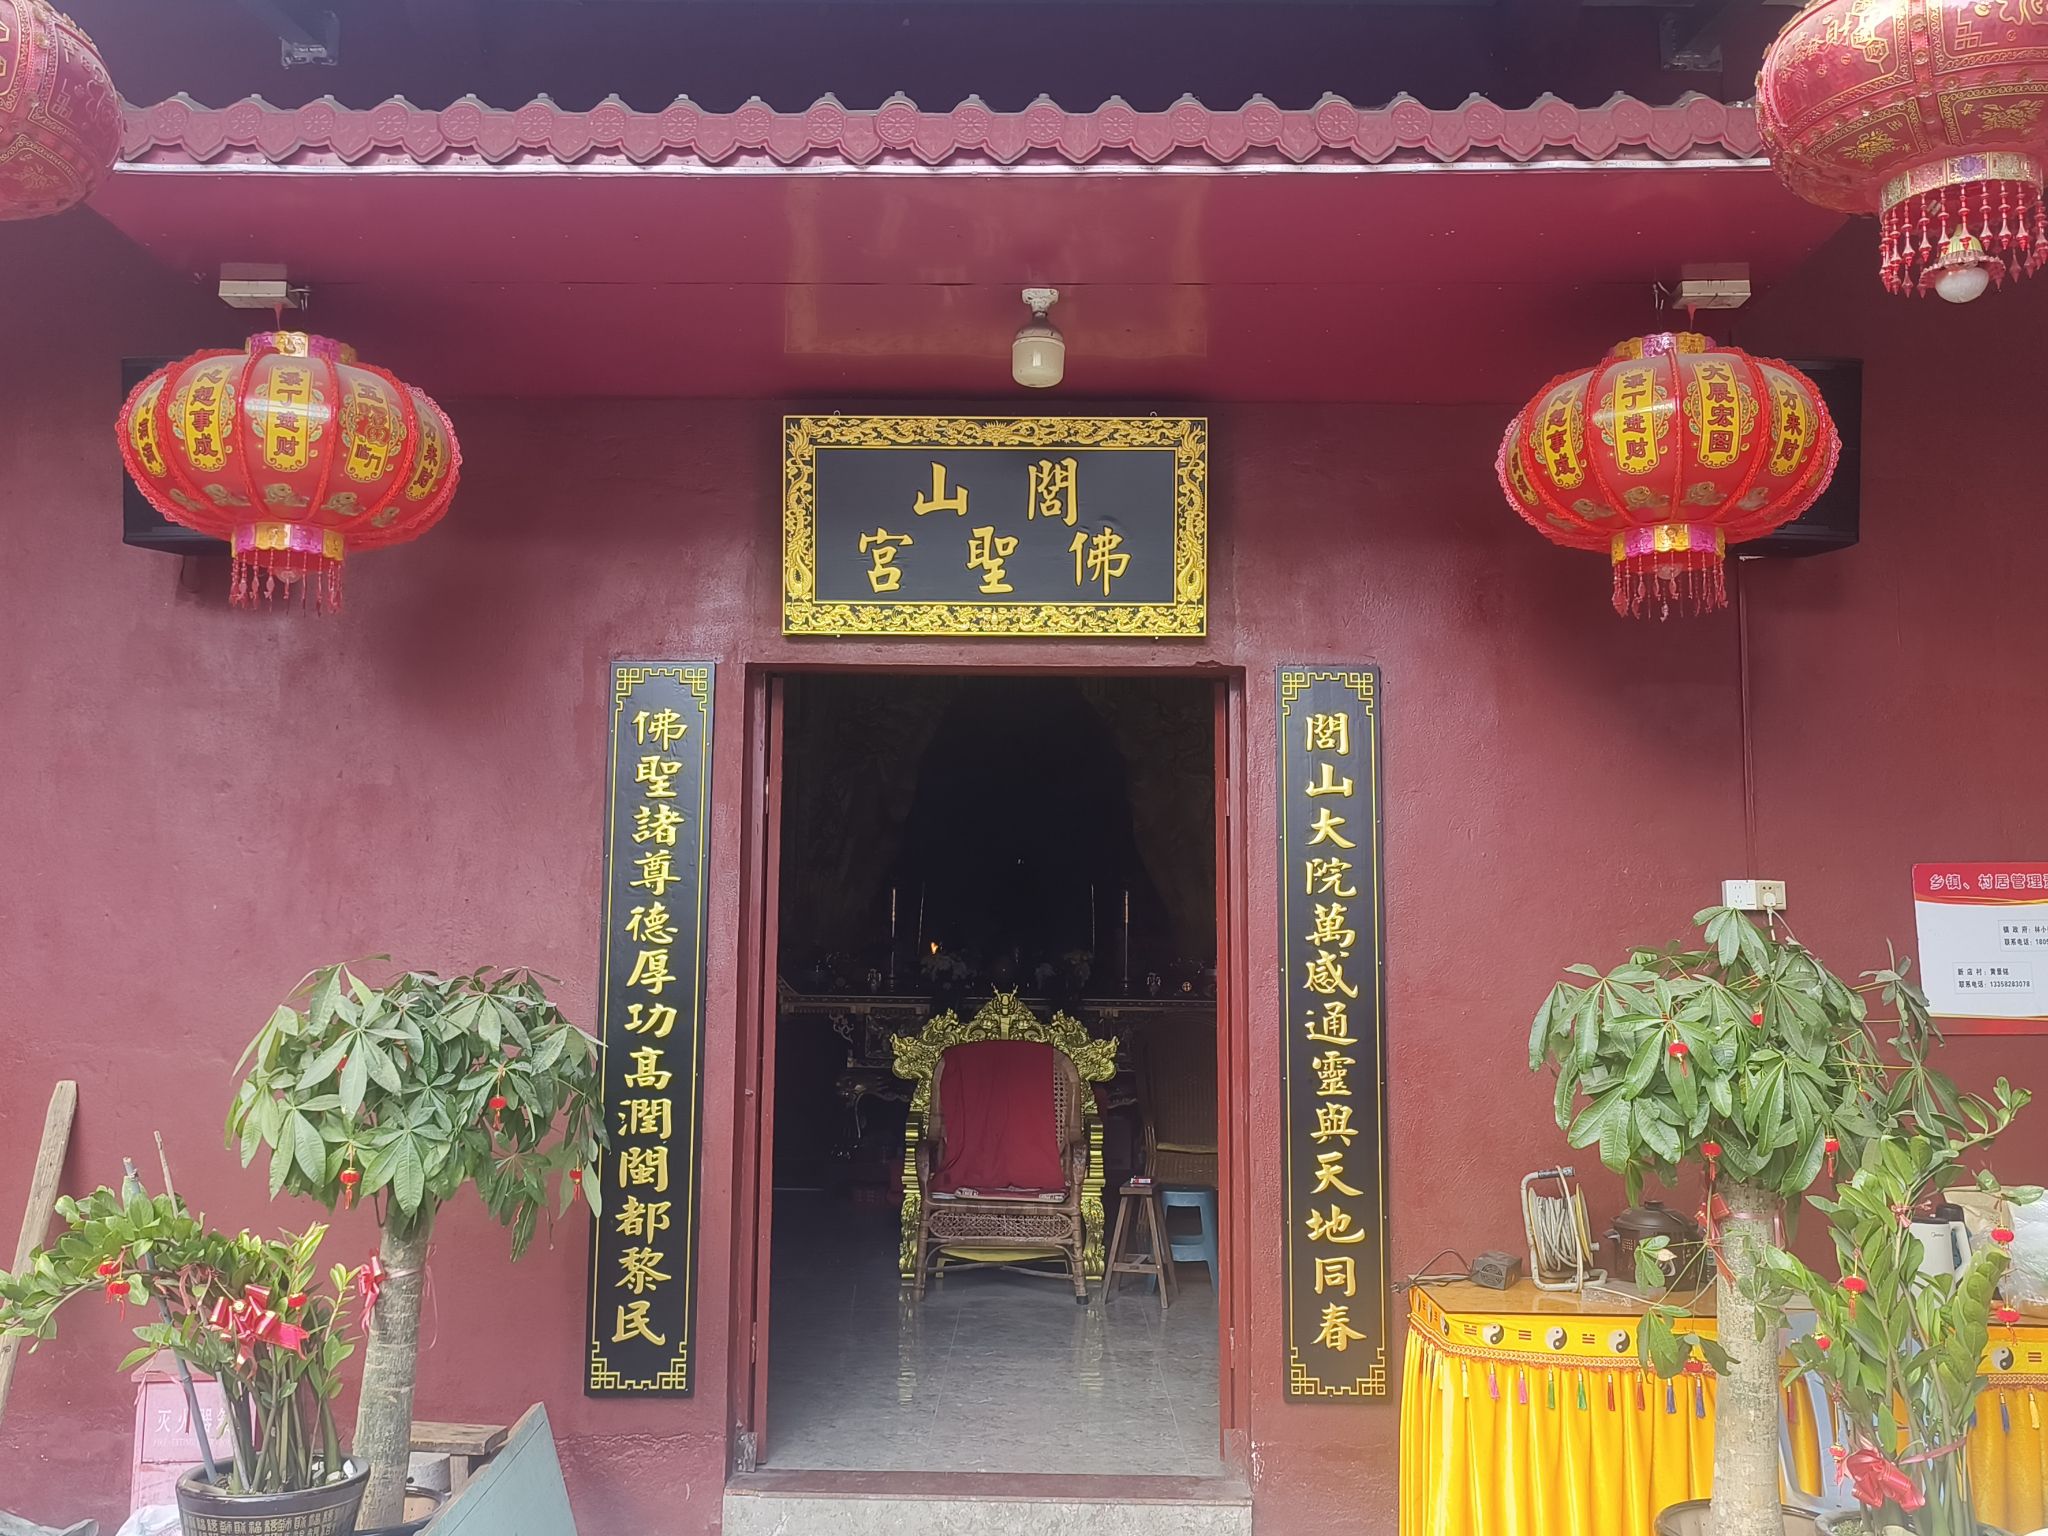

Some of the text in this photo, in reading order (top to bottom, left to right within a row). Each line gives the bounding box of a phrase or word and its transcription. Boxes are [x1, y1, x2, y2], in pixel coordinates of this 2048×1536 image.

[189, 369, 222, 457] 心想事成
[1702, 365, 1734, 453] 大展宏图
[858, 526, 1131, 597] 佛聖宮
[2002, 925, 2048, 934] 镇政府：林小
